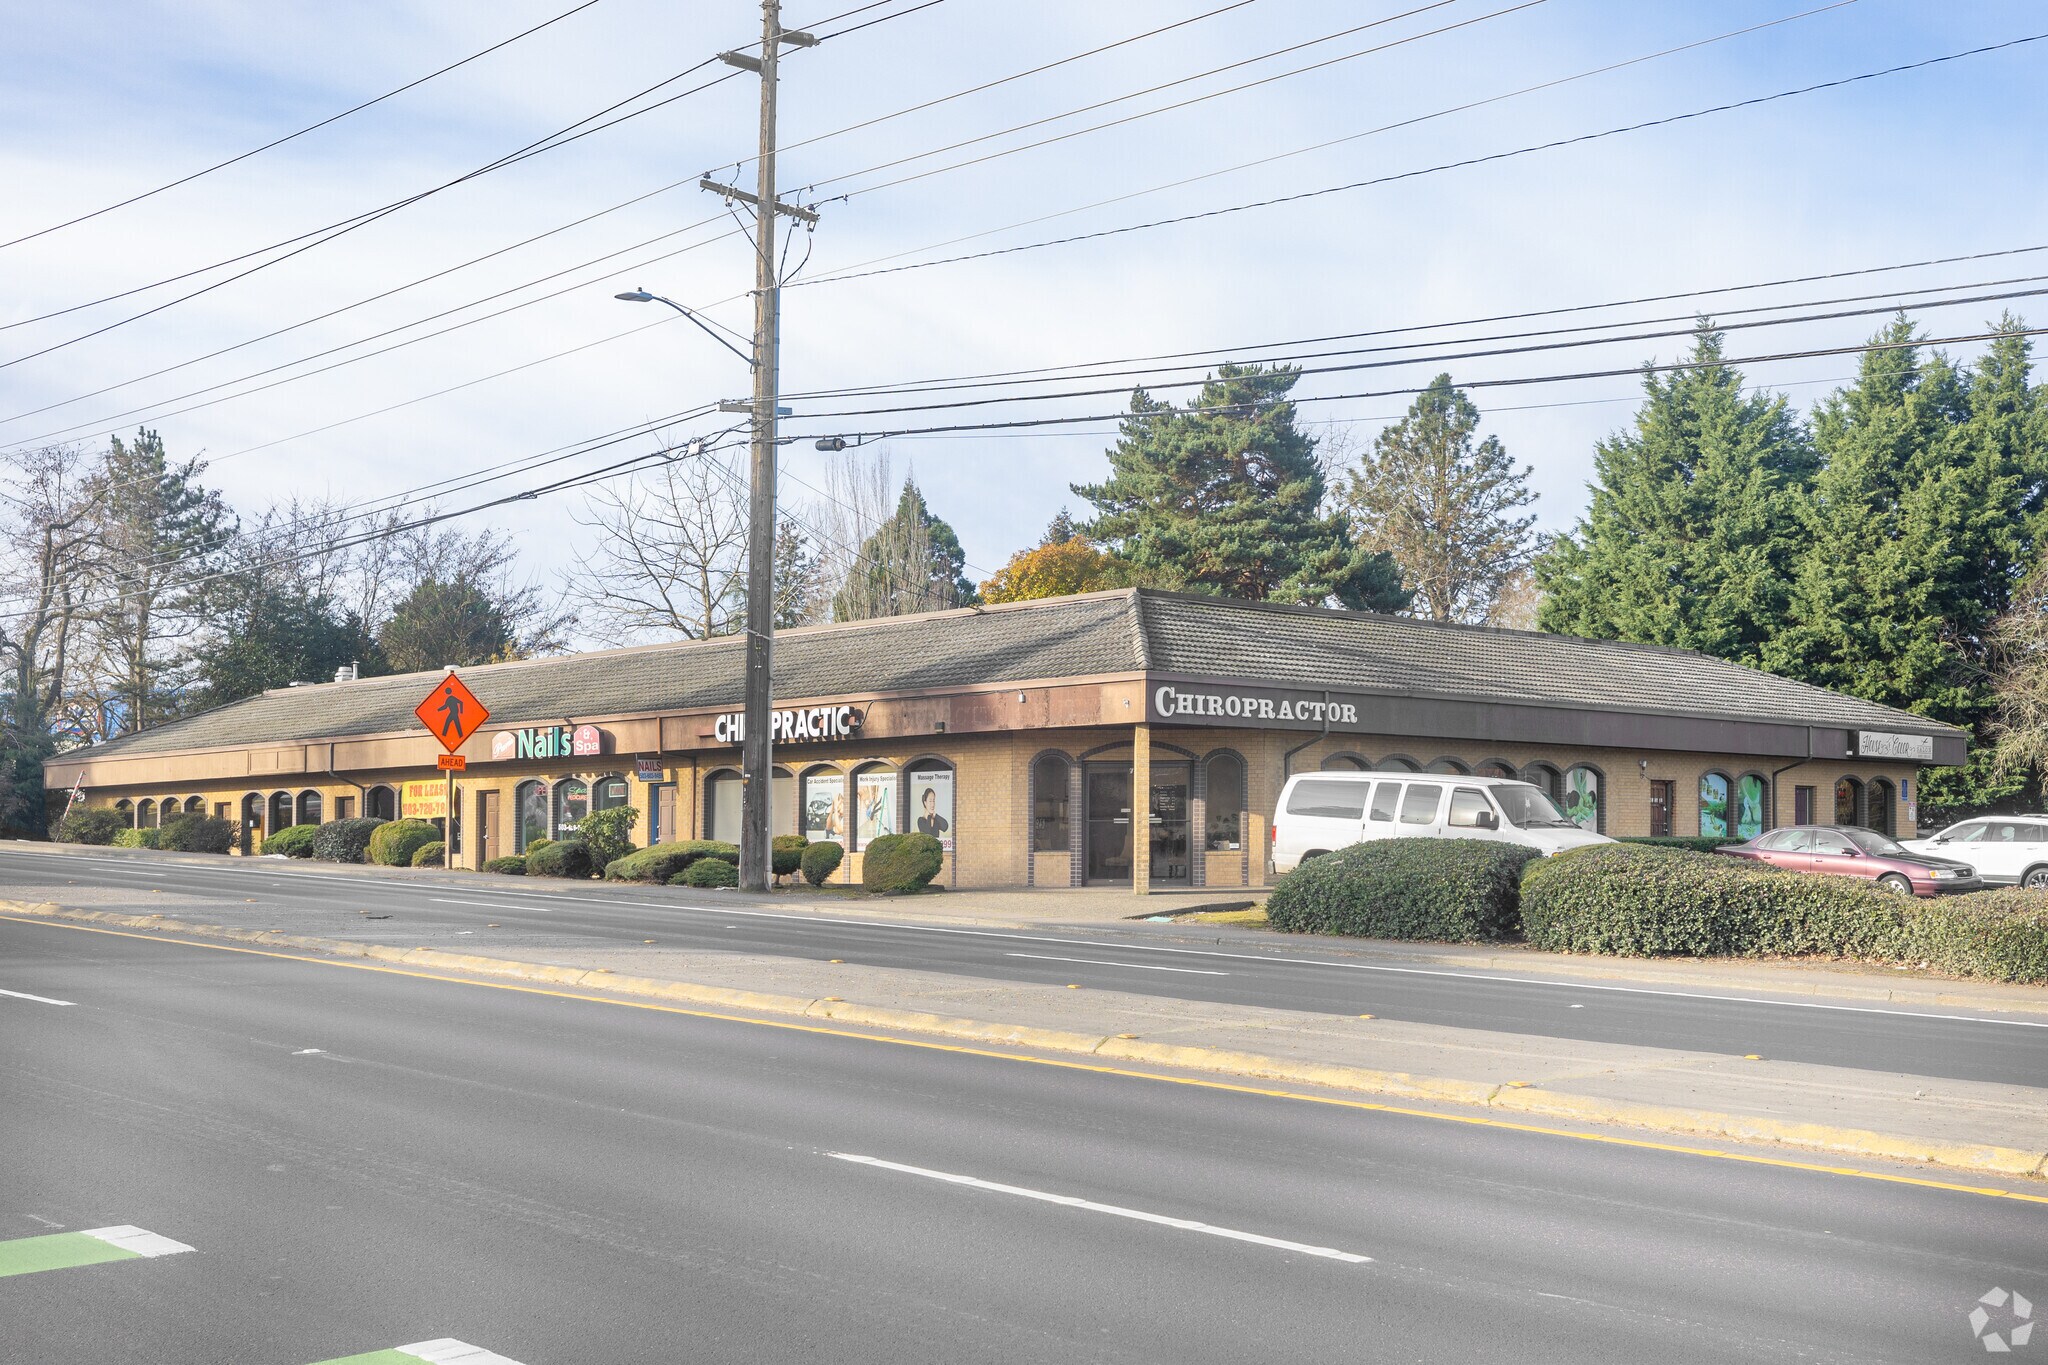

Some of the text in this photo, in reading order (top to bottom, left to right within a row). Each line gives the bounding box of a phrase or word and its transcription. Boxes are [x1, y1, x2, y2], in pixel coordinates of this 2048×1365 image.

[1154, 686, 1358, 723] CHIROPRACTOR
[715, 706, 850, 742] CHIPRACTIC
[518, 727, 572, 759] Nails
[576, 740, 599, 754] Spa
[441, 758, 463, 767] AHEAD
[638, 761, 662, 771] NAILS
[935, 773, 951, 781] Therapy
[409, 784, 423, 798] FOR
